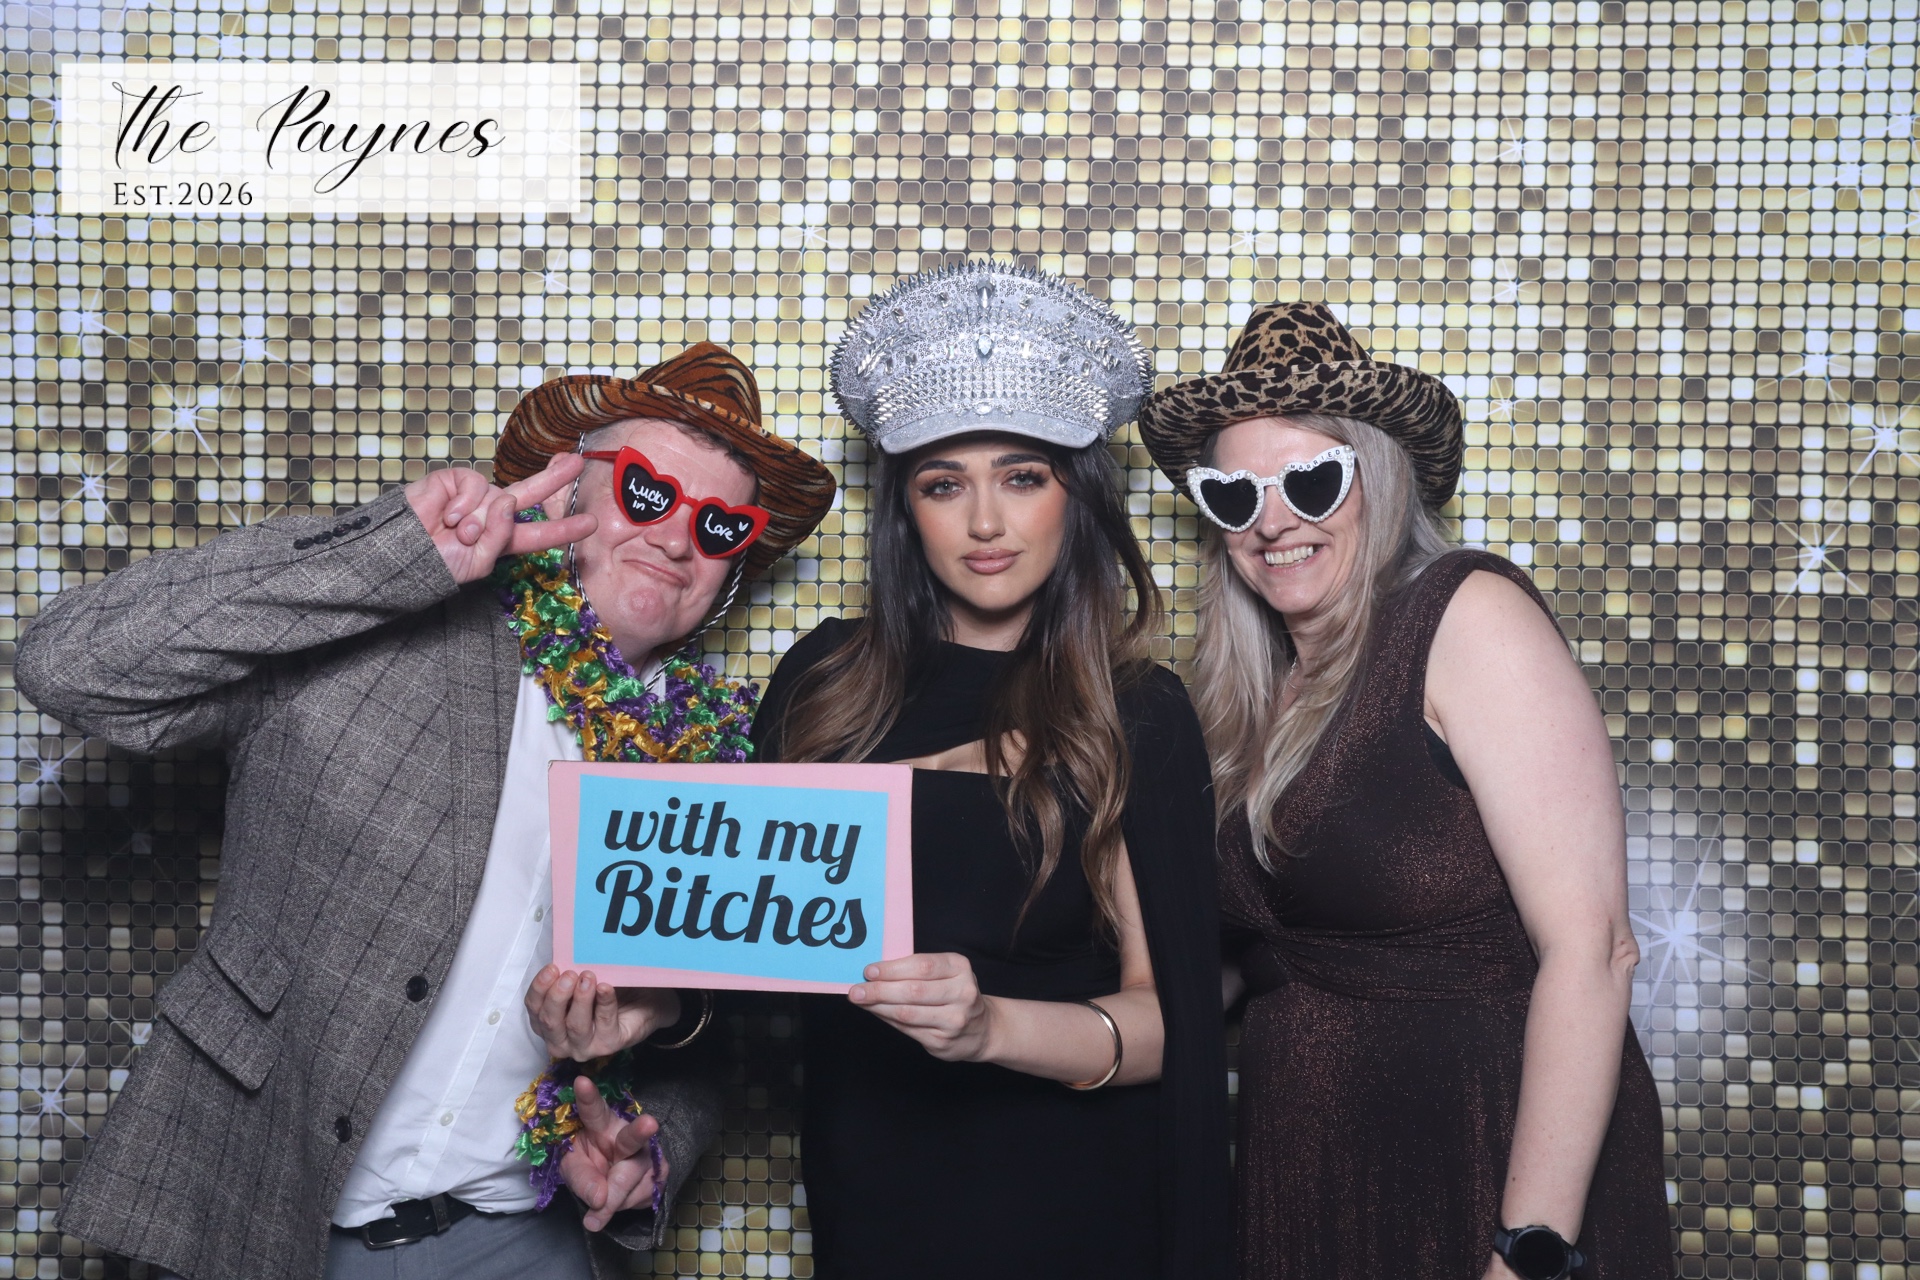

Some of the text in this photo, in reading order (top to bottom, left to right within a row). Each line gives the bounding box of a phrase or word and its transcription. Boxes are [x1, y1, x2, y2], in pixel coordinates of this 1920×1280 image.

[1214, 448, 1341, 483] JUST MARRIED
[628, 477, 669, 512] Lucky
[632, 495, 645, 511] in
[704, 512, 734, 541] Love
[604, 797, 862, 885] with my
[595, 860, 868, 950] Bitches
